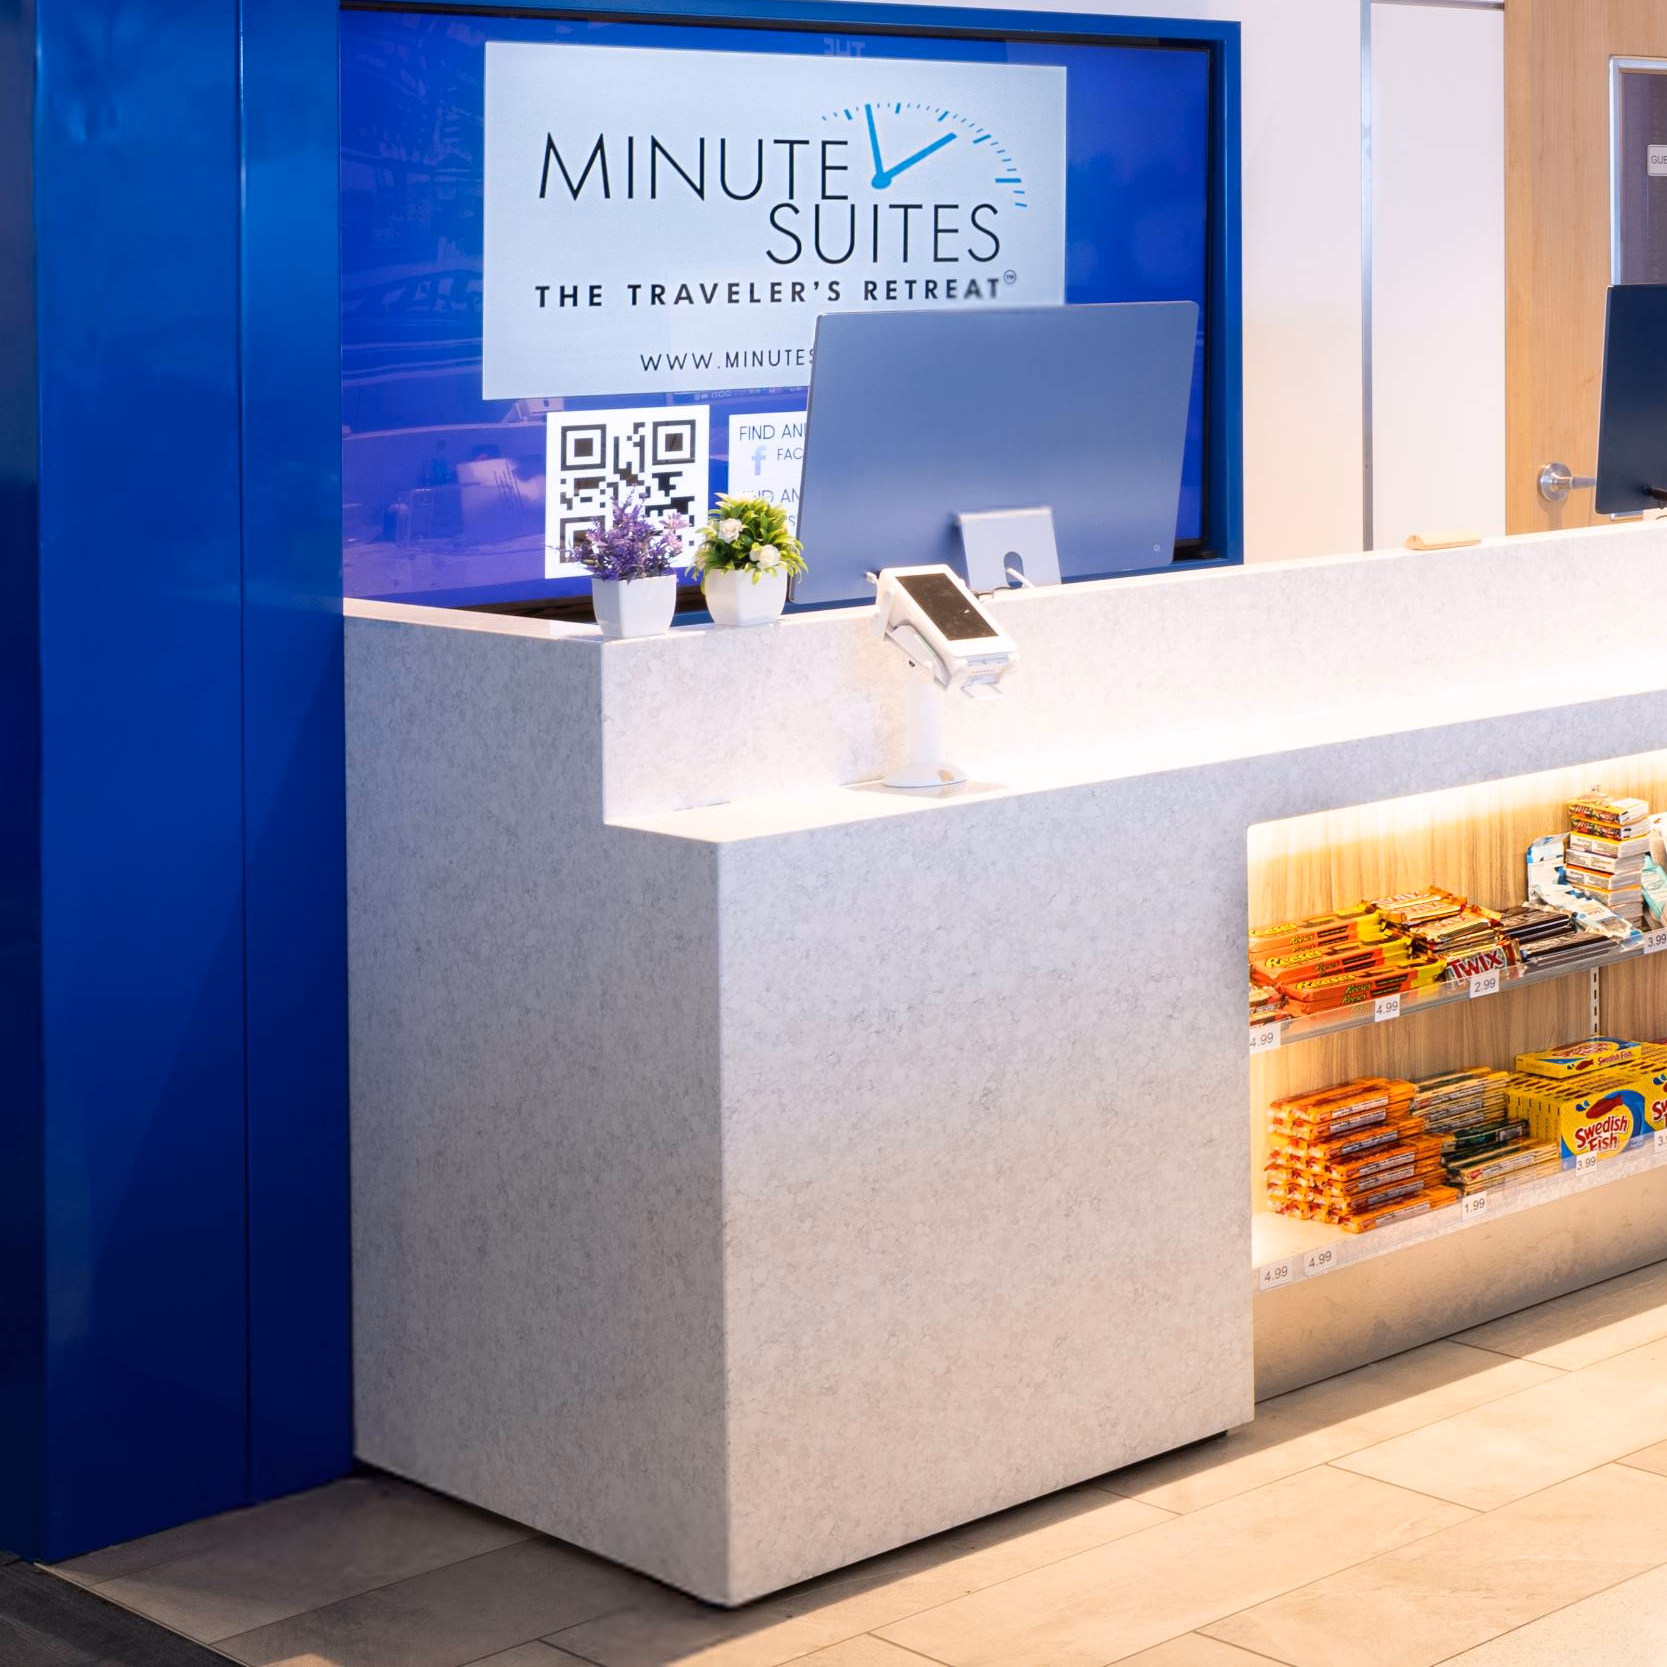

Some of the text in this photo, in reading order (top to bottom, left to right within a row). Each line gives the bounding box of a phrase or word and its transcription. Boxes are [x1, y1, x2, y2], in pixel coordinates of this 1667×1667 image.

[539, 131, 849, 201] MINUTE
[766, 202, 1000, 265] SUITES
[535, 284, 602, 308] THE
[627, 279, 842, 306] TRAVELER'S
[863, 278, 999, 301] RETREAT
[739, 423, 807, 441] FIND AN
[1648, 933, 1667, 948] 3.99
[1447, 947, 1505, 980] TWIX
[1474, 978, 1497, 993] 2.99
[1376, 1000, 1398, 1016] 4.99
[1250, 1032, 1274, 1047] 4.99
[1575, 1116, 1628, 1149] Swedish
[1588, 1132, 1618, 1151] Fish
[1577, 1156, 1597, 1171] 3.99
[1464, 1198, 1485, 1213] 1.99
[1309, 1250, 1332, 1268] 4.99
[1264, 1265, 1288, 1282] 4.99
